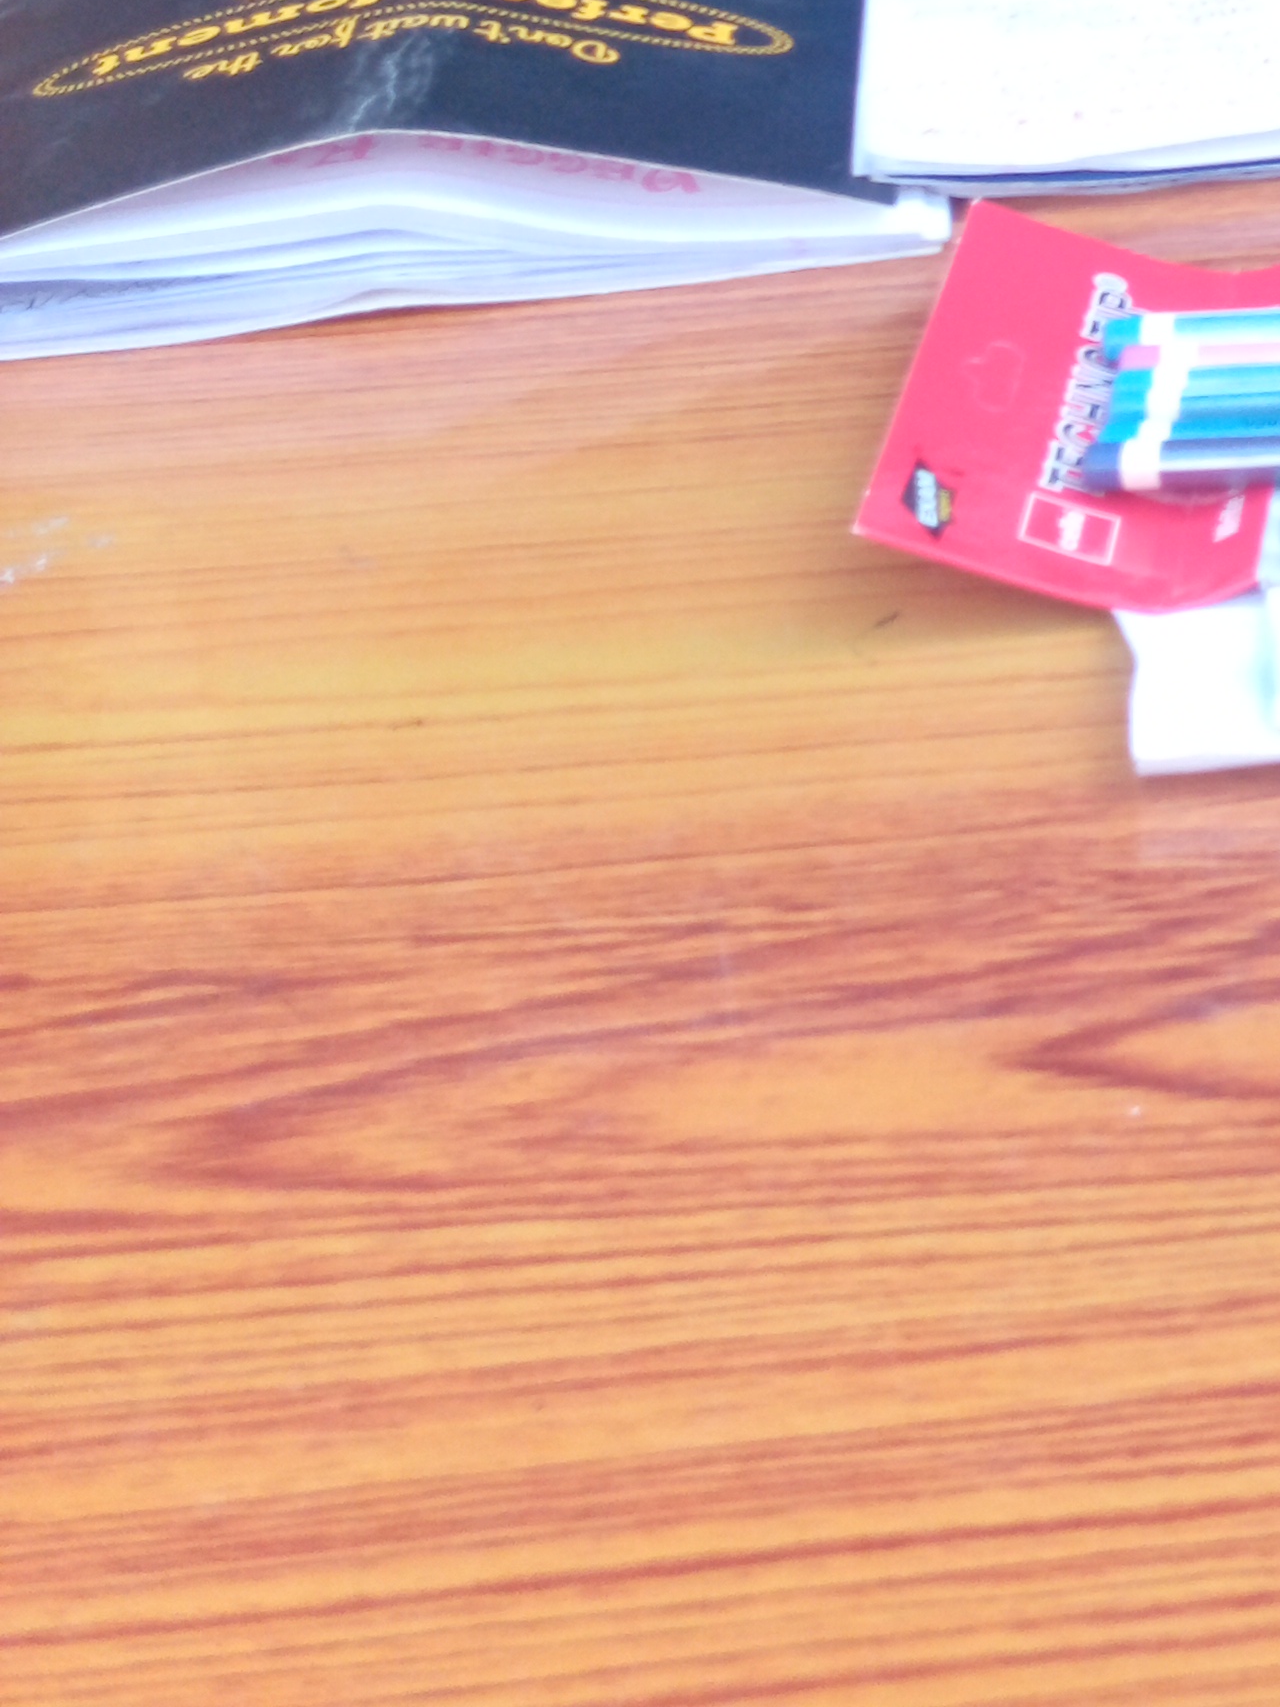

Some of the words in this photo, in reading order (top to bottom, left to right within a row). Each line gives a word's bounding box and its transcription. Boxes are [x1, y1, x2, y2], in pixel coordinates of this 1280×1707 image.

[270, 13, 360, 57] for
[359, 13, 470, 42] wait
[473, 17, 621, 65] Don't
[182, 50, 263, 81] the
